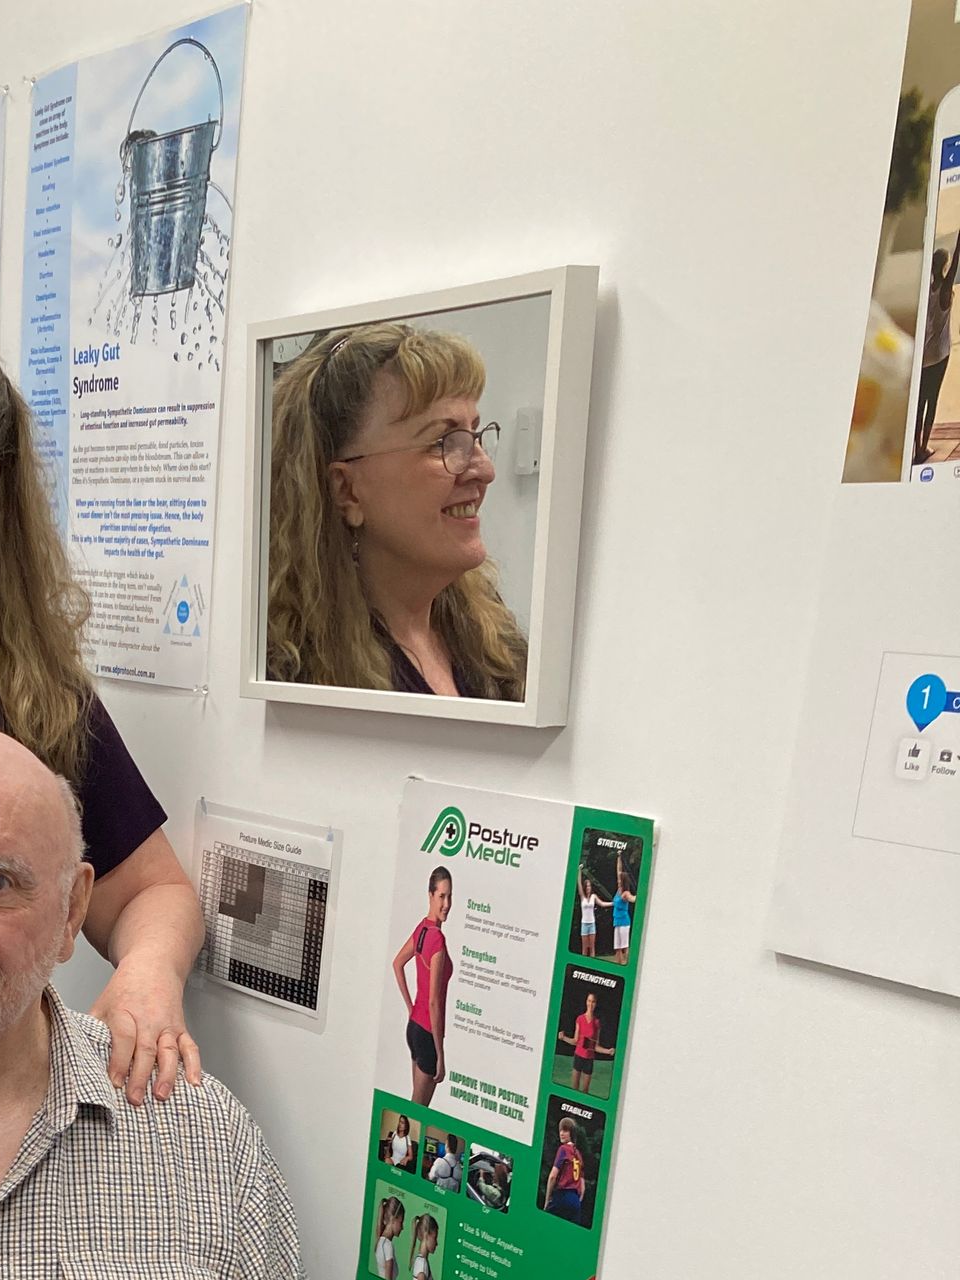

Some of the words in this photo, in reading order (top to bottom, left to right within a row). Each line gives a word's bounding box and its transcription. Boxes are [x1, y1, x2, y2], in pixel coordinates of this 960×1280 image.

[73, 344, 100, 367] Leaky
[102, 342, 121, 362] Gut
[73, 373, 119, 399] Syndrome
[103, 419, 119, 429] function
[120, 419, 128, 429] and
[128, 417, 148, 428] increased
[149, 418, 157, 429] gut
[107, 407, 132, 420] Sympathetic
[133, 405, 157, 415] Dominance
[166, 403, 180, 412] result
[187, 402, 215, 414] suppression
[100, 664, 156, 679] www.sdprotocol.com.au
[921, 684, 931, 710] 1
[904, 762, 920, 772] Like
[931, 765, 957, 776] Follow
[240, 832, 257, 845] Posture
[258, 836, 272, 849] Medic
[273, 840, 285, 852] Size
[285, 843, 302, 855] Guide
[468, 822, 539, 851] Posture
[596, 837, 627, 850] STRETCH
[465, 841, 521, 868] Medic
[467, 898, 491, 914] Stretch
[464, 923, 480, 931] posture
[490, 930, 503, 938] range
[510, 934, 525, 942] motion
[465, 914, 482, 923] Release
[496, 922, 513, 931] muscles
[521, 928, 539, 938] improve
[462, 945, 497, 964] Strengthen
[459, 977, 473, 986] correct
[474, 981, 491, 991] posture
[460, 960, 474, 969] Simple
[475, 964, 494, 975] exercises
[505, 973, 530, 984] strengthen
[460, 969, 476, 978] muscles
[477, 974, 500, 985] associated
[511, 983, 536, 997] maintaining
[572, 970, 617, 989] STRENGTHEN
[456, 999, 482, 1016] Stabilize
[453, 1023, 468, 1031] remind
[482, 1031, 500, 1041] maintain
[501, 1037, 515, 1047] better
[516, 1042, 533, 1052] posture
[455, 1014, 466, 1022] Wear
[475, 1020, 491, 1030] Posture
[492, 1025, 505, 1035] Medic
[512, 1032, 525, 1042] gently
[449, 1070, 478, 1090] IMPROVE
[479, 1080, 497, 1096] YOUR
[498, 1087, 529, 1108] POSTURE.
[450, 1085, 479, 1106] IMPROVE
[480, 1096, 498, 1112] YOUR
[499, 1103, 525, 1123] HEALTH.
[560, 1103, 593, 1120] STABILIZE
[424, 1202, 439, 1213] AFTER
[463, 1223, 475, 1234] Use
[475, 1228, 480, 1237] &
[481, 1230, 497, 1243] Wear
[497, 1238, 524, 1256] Anywhere
[462, 1239, 490, 1258] Immediate
[490, 1251, 512, 1268] Results
[461, 1254, 479, 1270] Simple
[479, 1264, 486, 1273] to
[486, 1267, 498, 1278] Use
